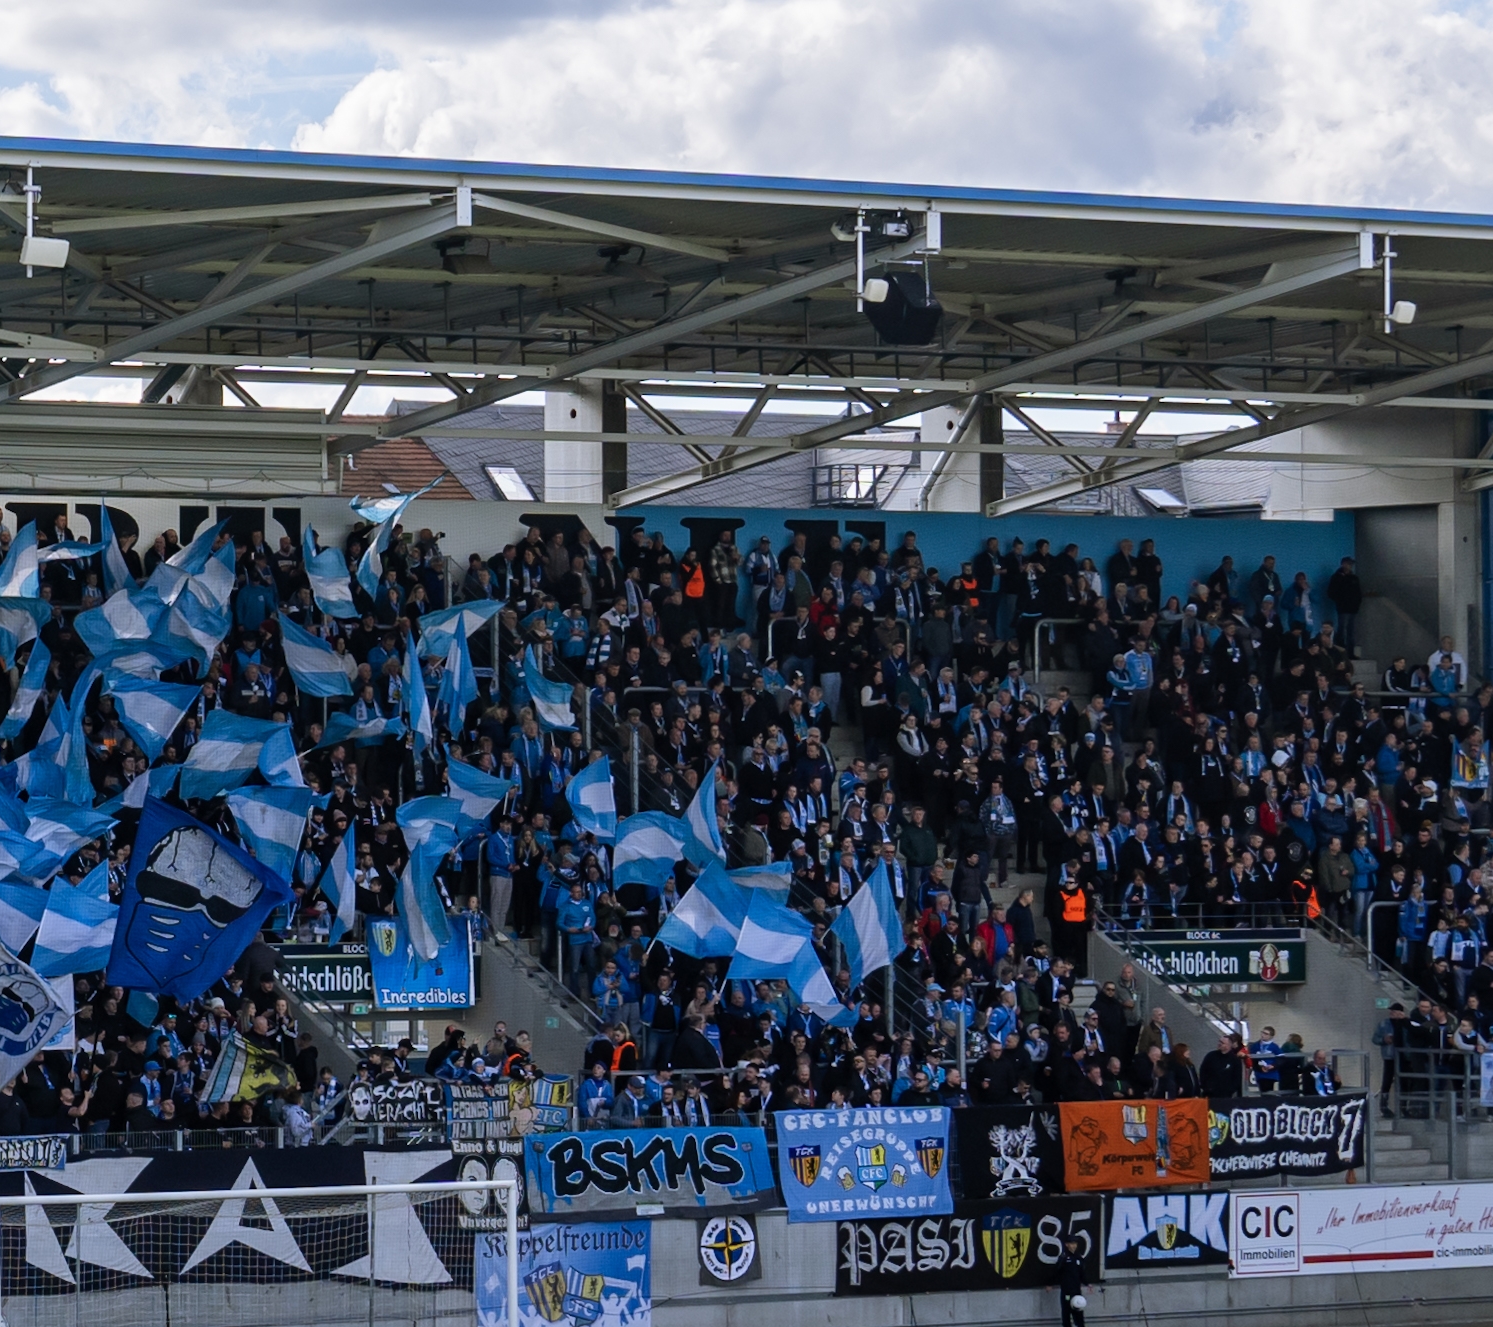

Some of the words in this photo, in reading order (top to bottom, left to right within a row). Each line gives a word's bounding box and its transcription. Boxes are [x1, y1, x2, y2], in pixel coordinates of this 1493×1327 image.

[342, 944, 369, 954] BLOC
[382, 988, 467, 1005] Incredibles
[1231, 1108, 1271, 1142] OLD
[1274, 1104, 1336, 1140] BLOCK
[452, 1139, 483, 1153] Enno
[486, 1139, 496, 1154] &
[820, 1128, 923, 1181] REISEGRUPPE
[547, 1132, 744, 1197] BSKMS
[861, 1168, 883, 1180] CFC
[807, 1194, 937, 1215] UNERWÜNSCHT
[1351, 1187, 1461, 1225] Immobilienverkauf
[1106, 1191, 1230, 1258] AHK
[1241, 1205, 1294, 1239] CIC
[1424, 1218, 1435, 1240] in
[1437, 1216, 1474, 1242] guten
[1036, 1210, 1093, 1266] 85
[1239, 1248, 1296, 1262] Immobilien
